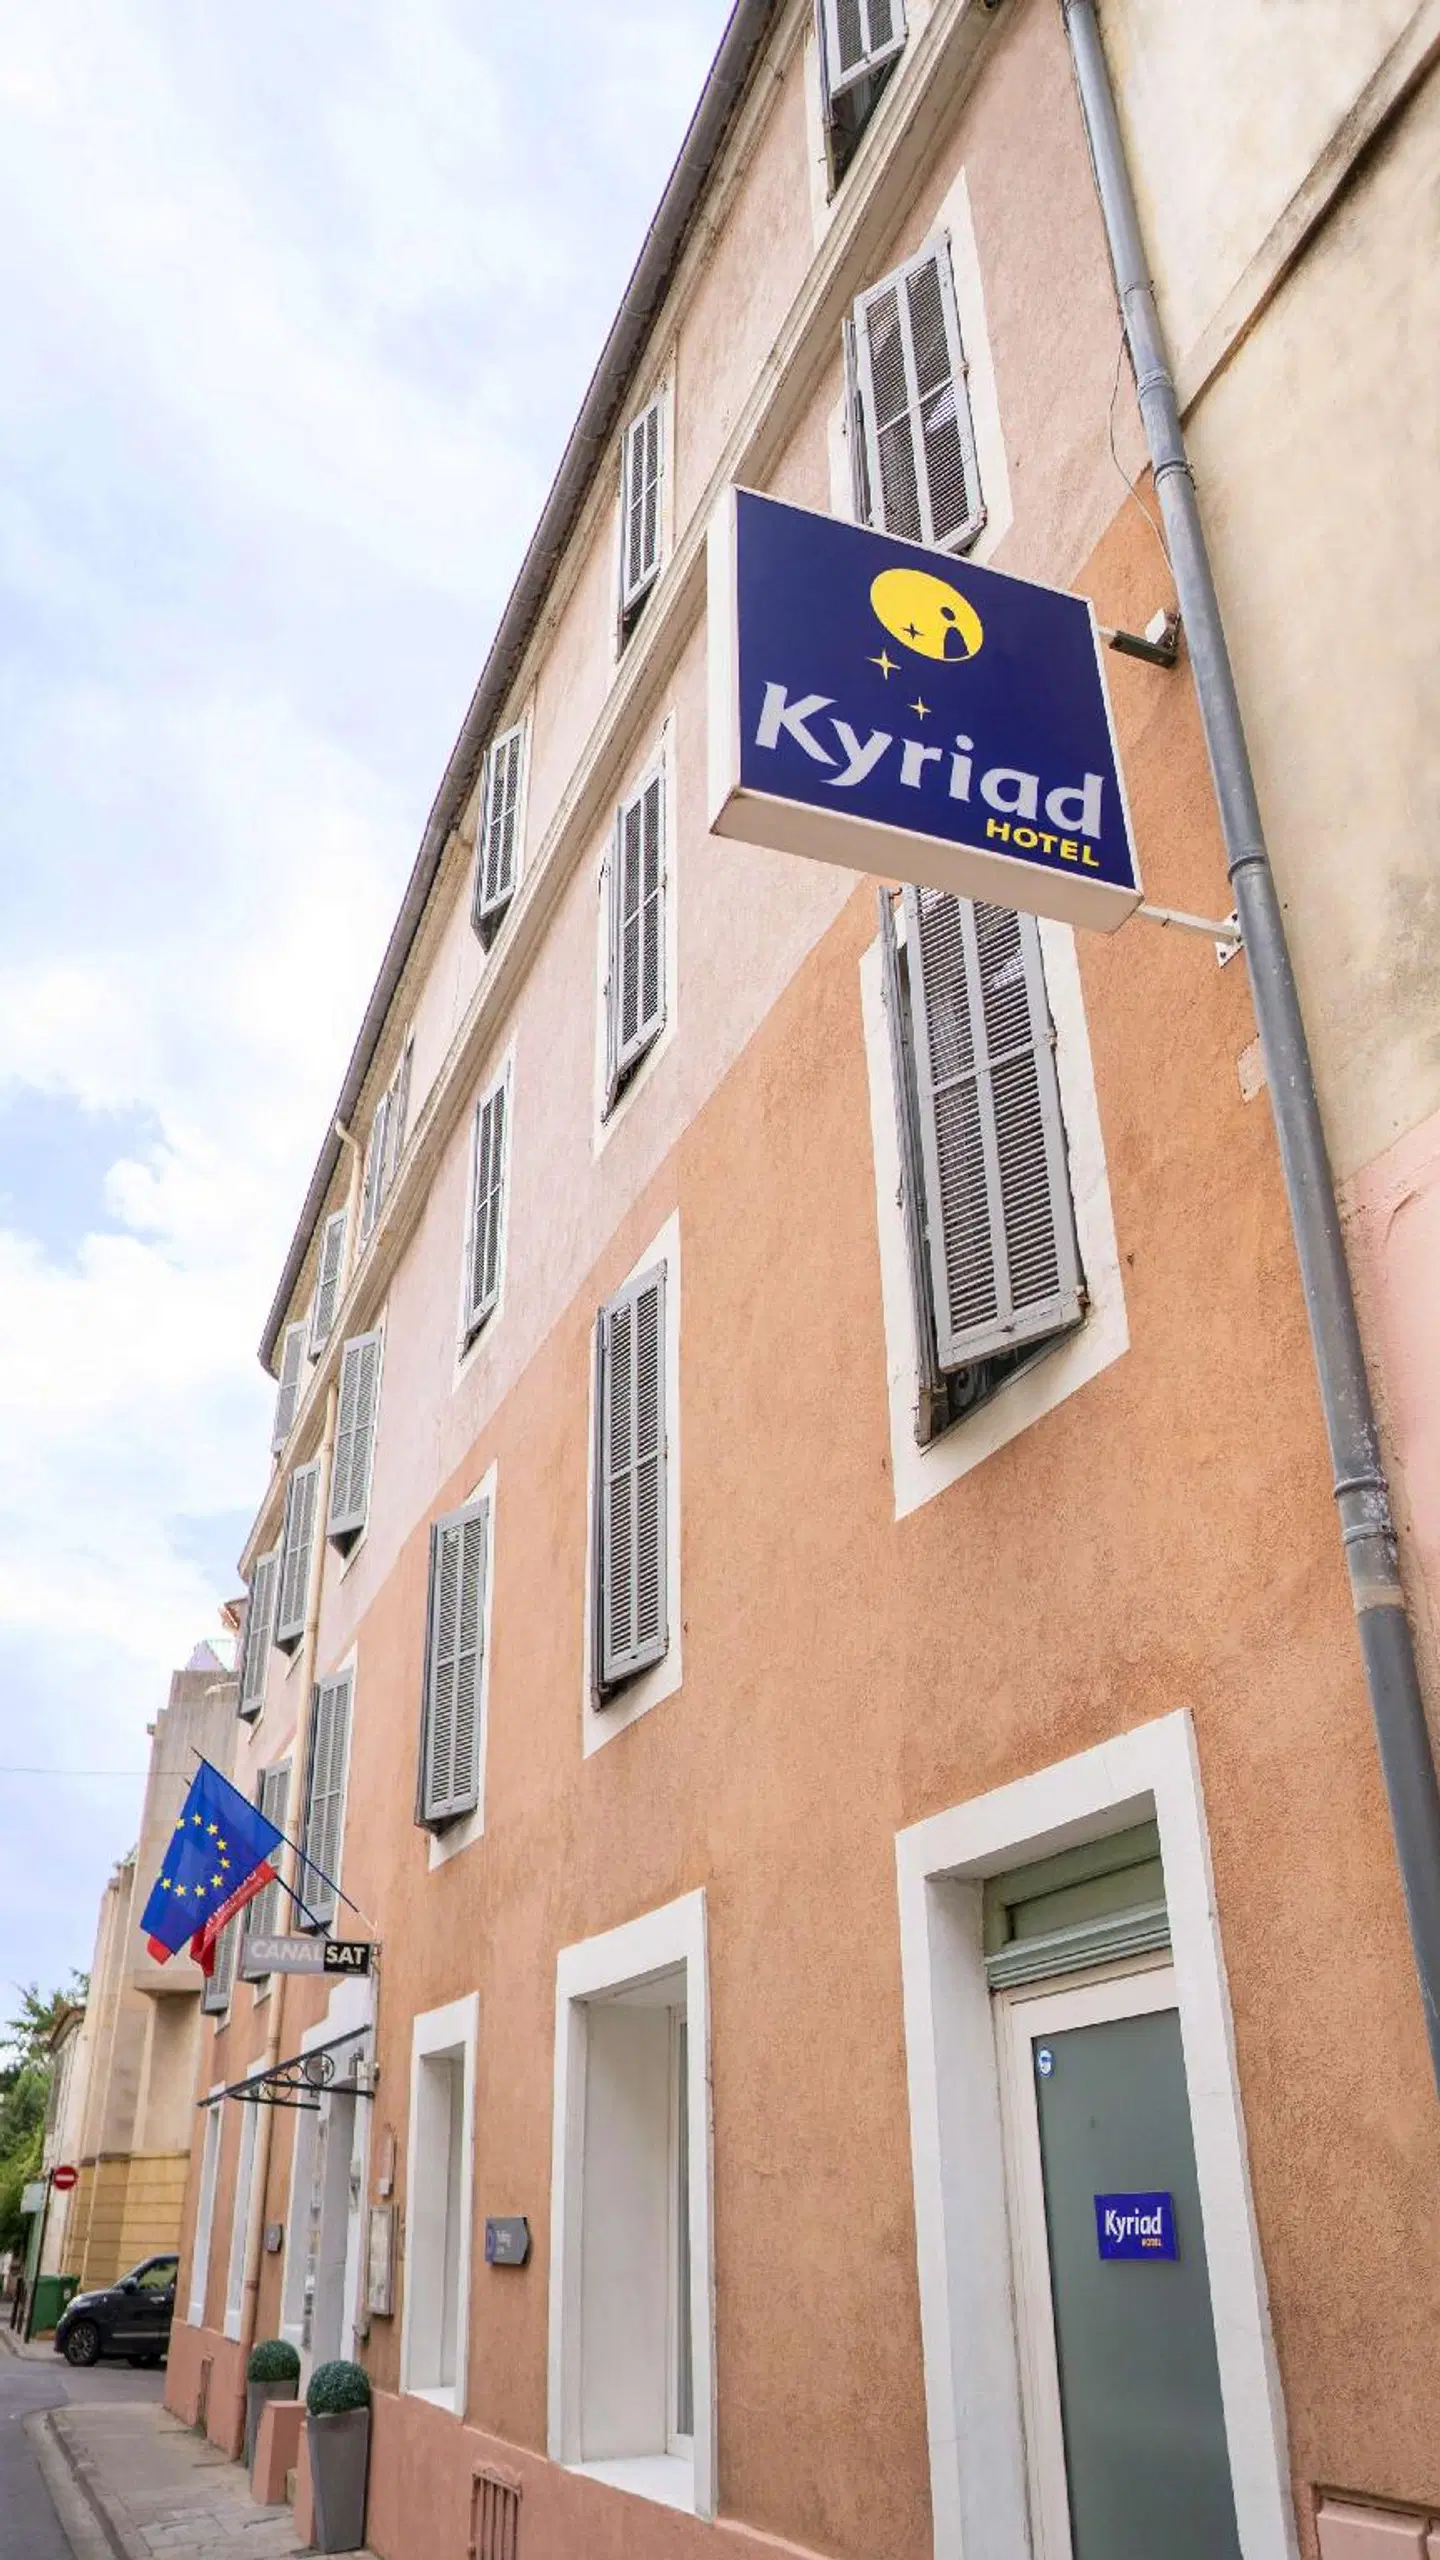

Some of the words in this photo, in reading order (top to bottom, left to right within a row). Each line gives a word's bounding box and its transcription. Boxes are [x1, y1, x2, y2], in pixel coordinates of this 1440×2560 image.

[755, 681, 1104, 839] Kyriad
[986, 818, 1099, 867] HOTEL
[1105, 2206, 1162, 2243] Kyriad
